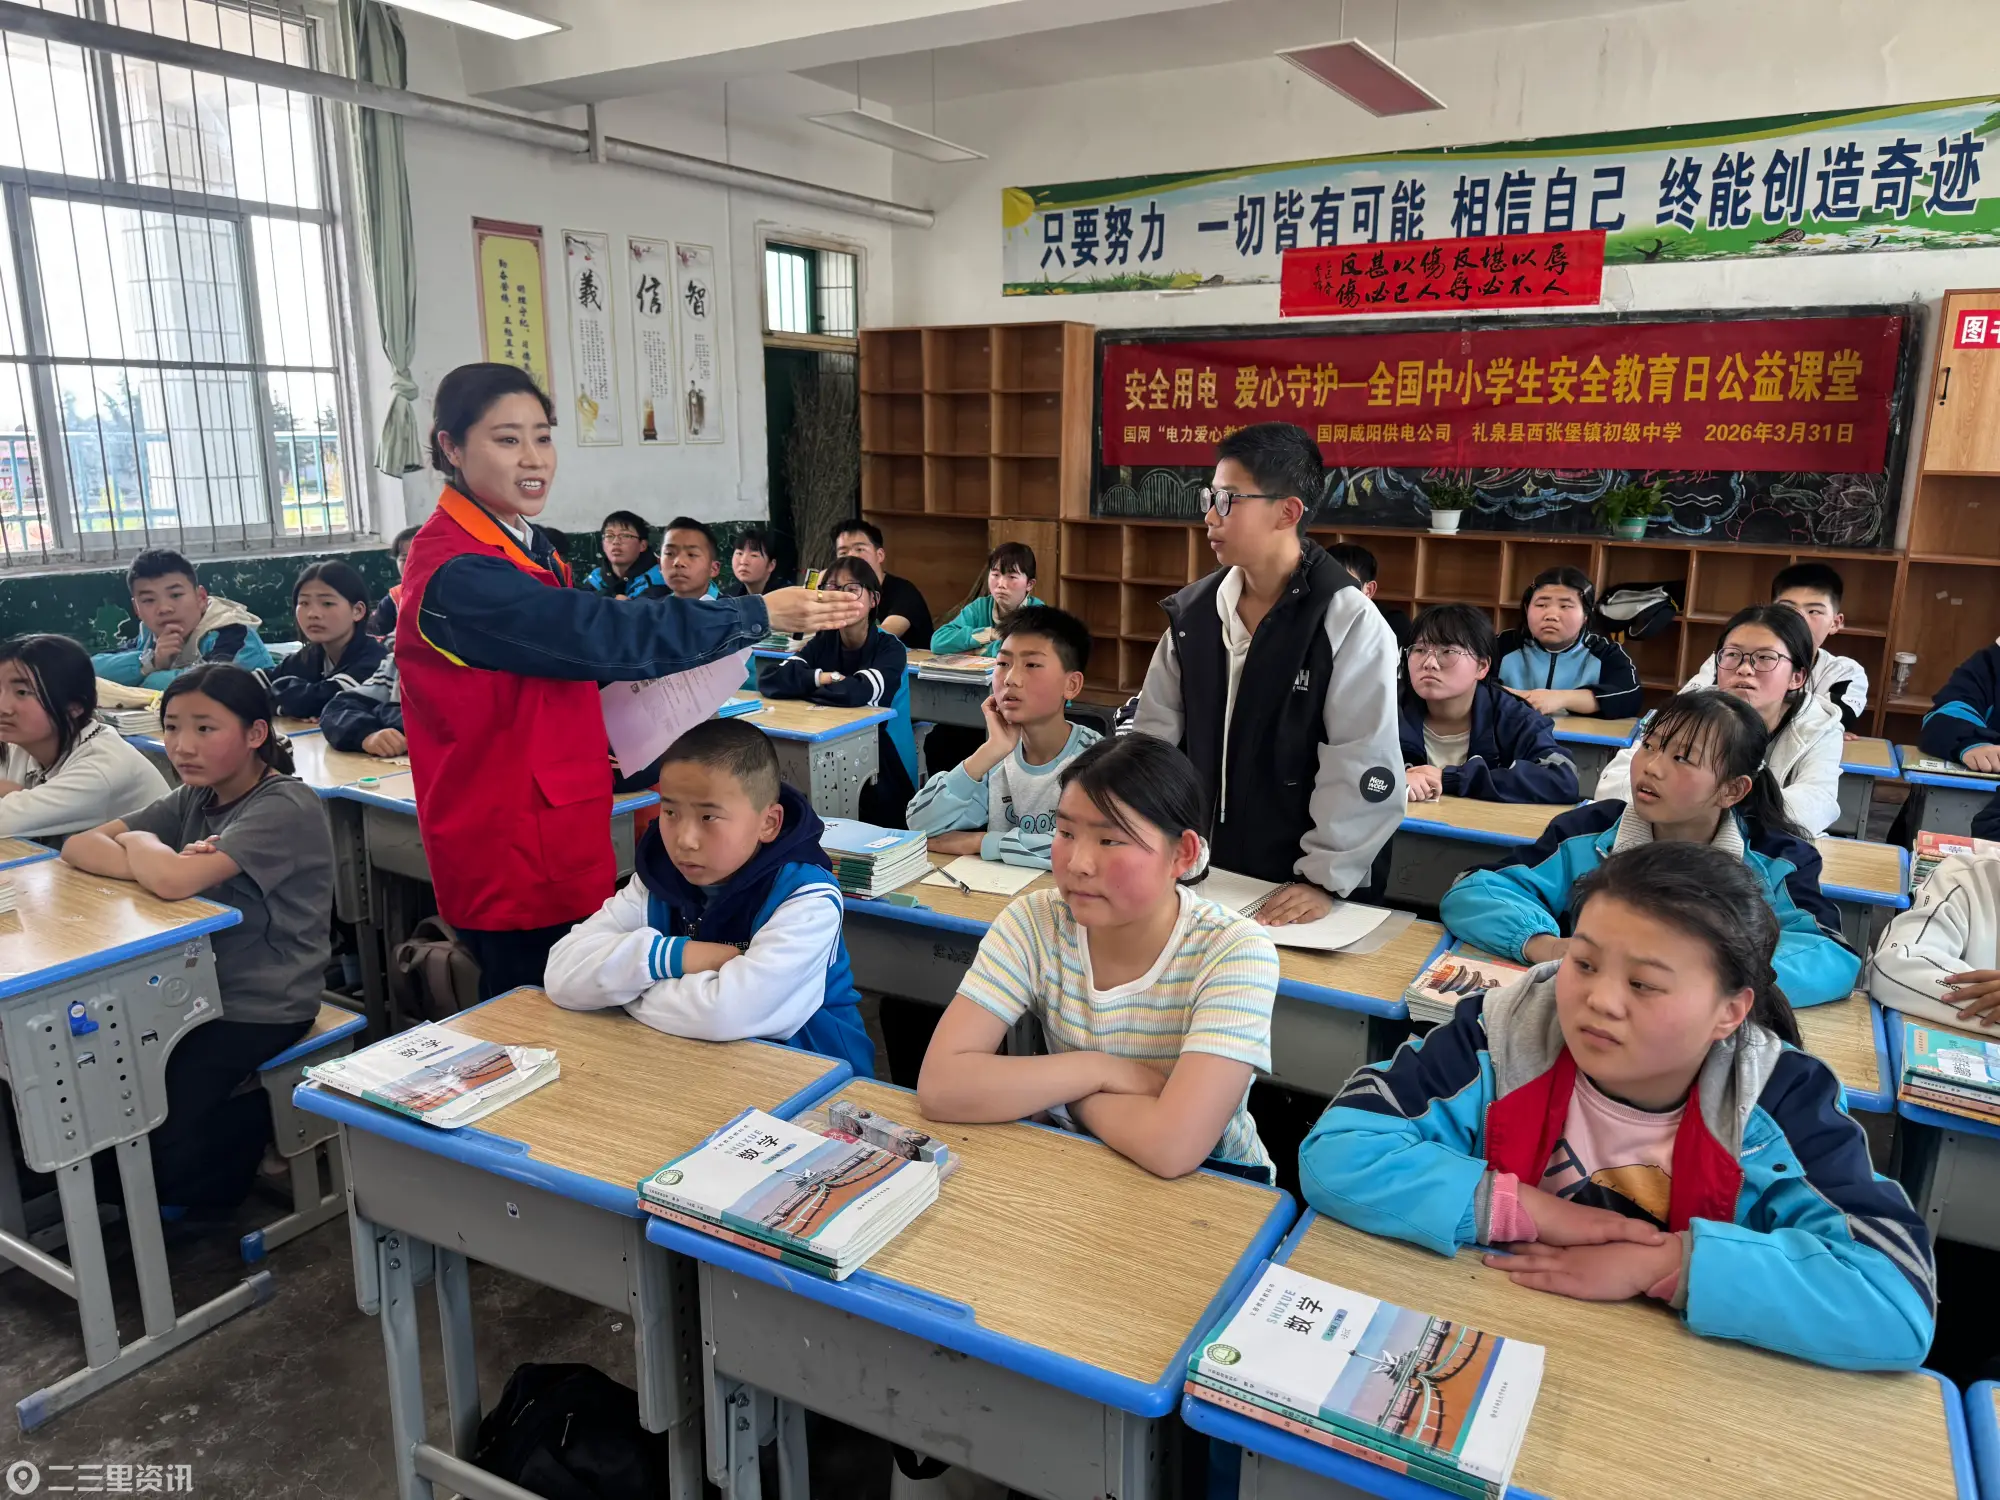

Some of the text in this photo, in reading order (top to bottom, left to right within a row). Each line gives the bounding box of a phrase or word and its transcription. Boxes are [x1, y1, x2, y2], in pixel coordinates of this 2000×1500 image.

[1040, 132, 1985, 269] 只要努力 一切皆有可能 相信自己 终能创造奇迹
[636, 274, 662, 314] 信
[685, 280, 707, 318] 智
[1124, 366, 1218, 411] 安全用电
[1317, 423, 1451, 443] 国网咸阳供电公司
[1472, 421, 1682, 444] 礼泉县西张堡镇初级中学
[1704, 421, 1854, 444] 2026年3月31日
[736, 1134, 780, 1161] 数学
[1266, 1289, 1296, 1324] SHUXUE
[1284, 1296, 1324, 1335] 数学
